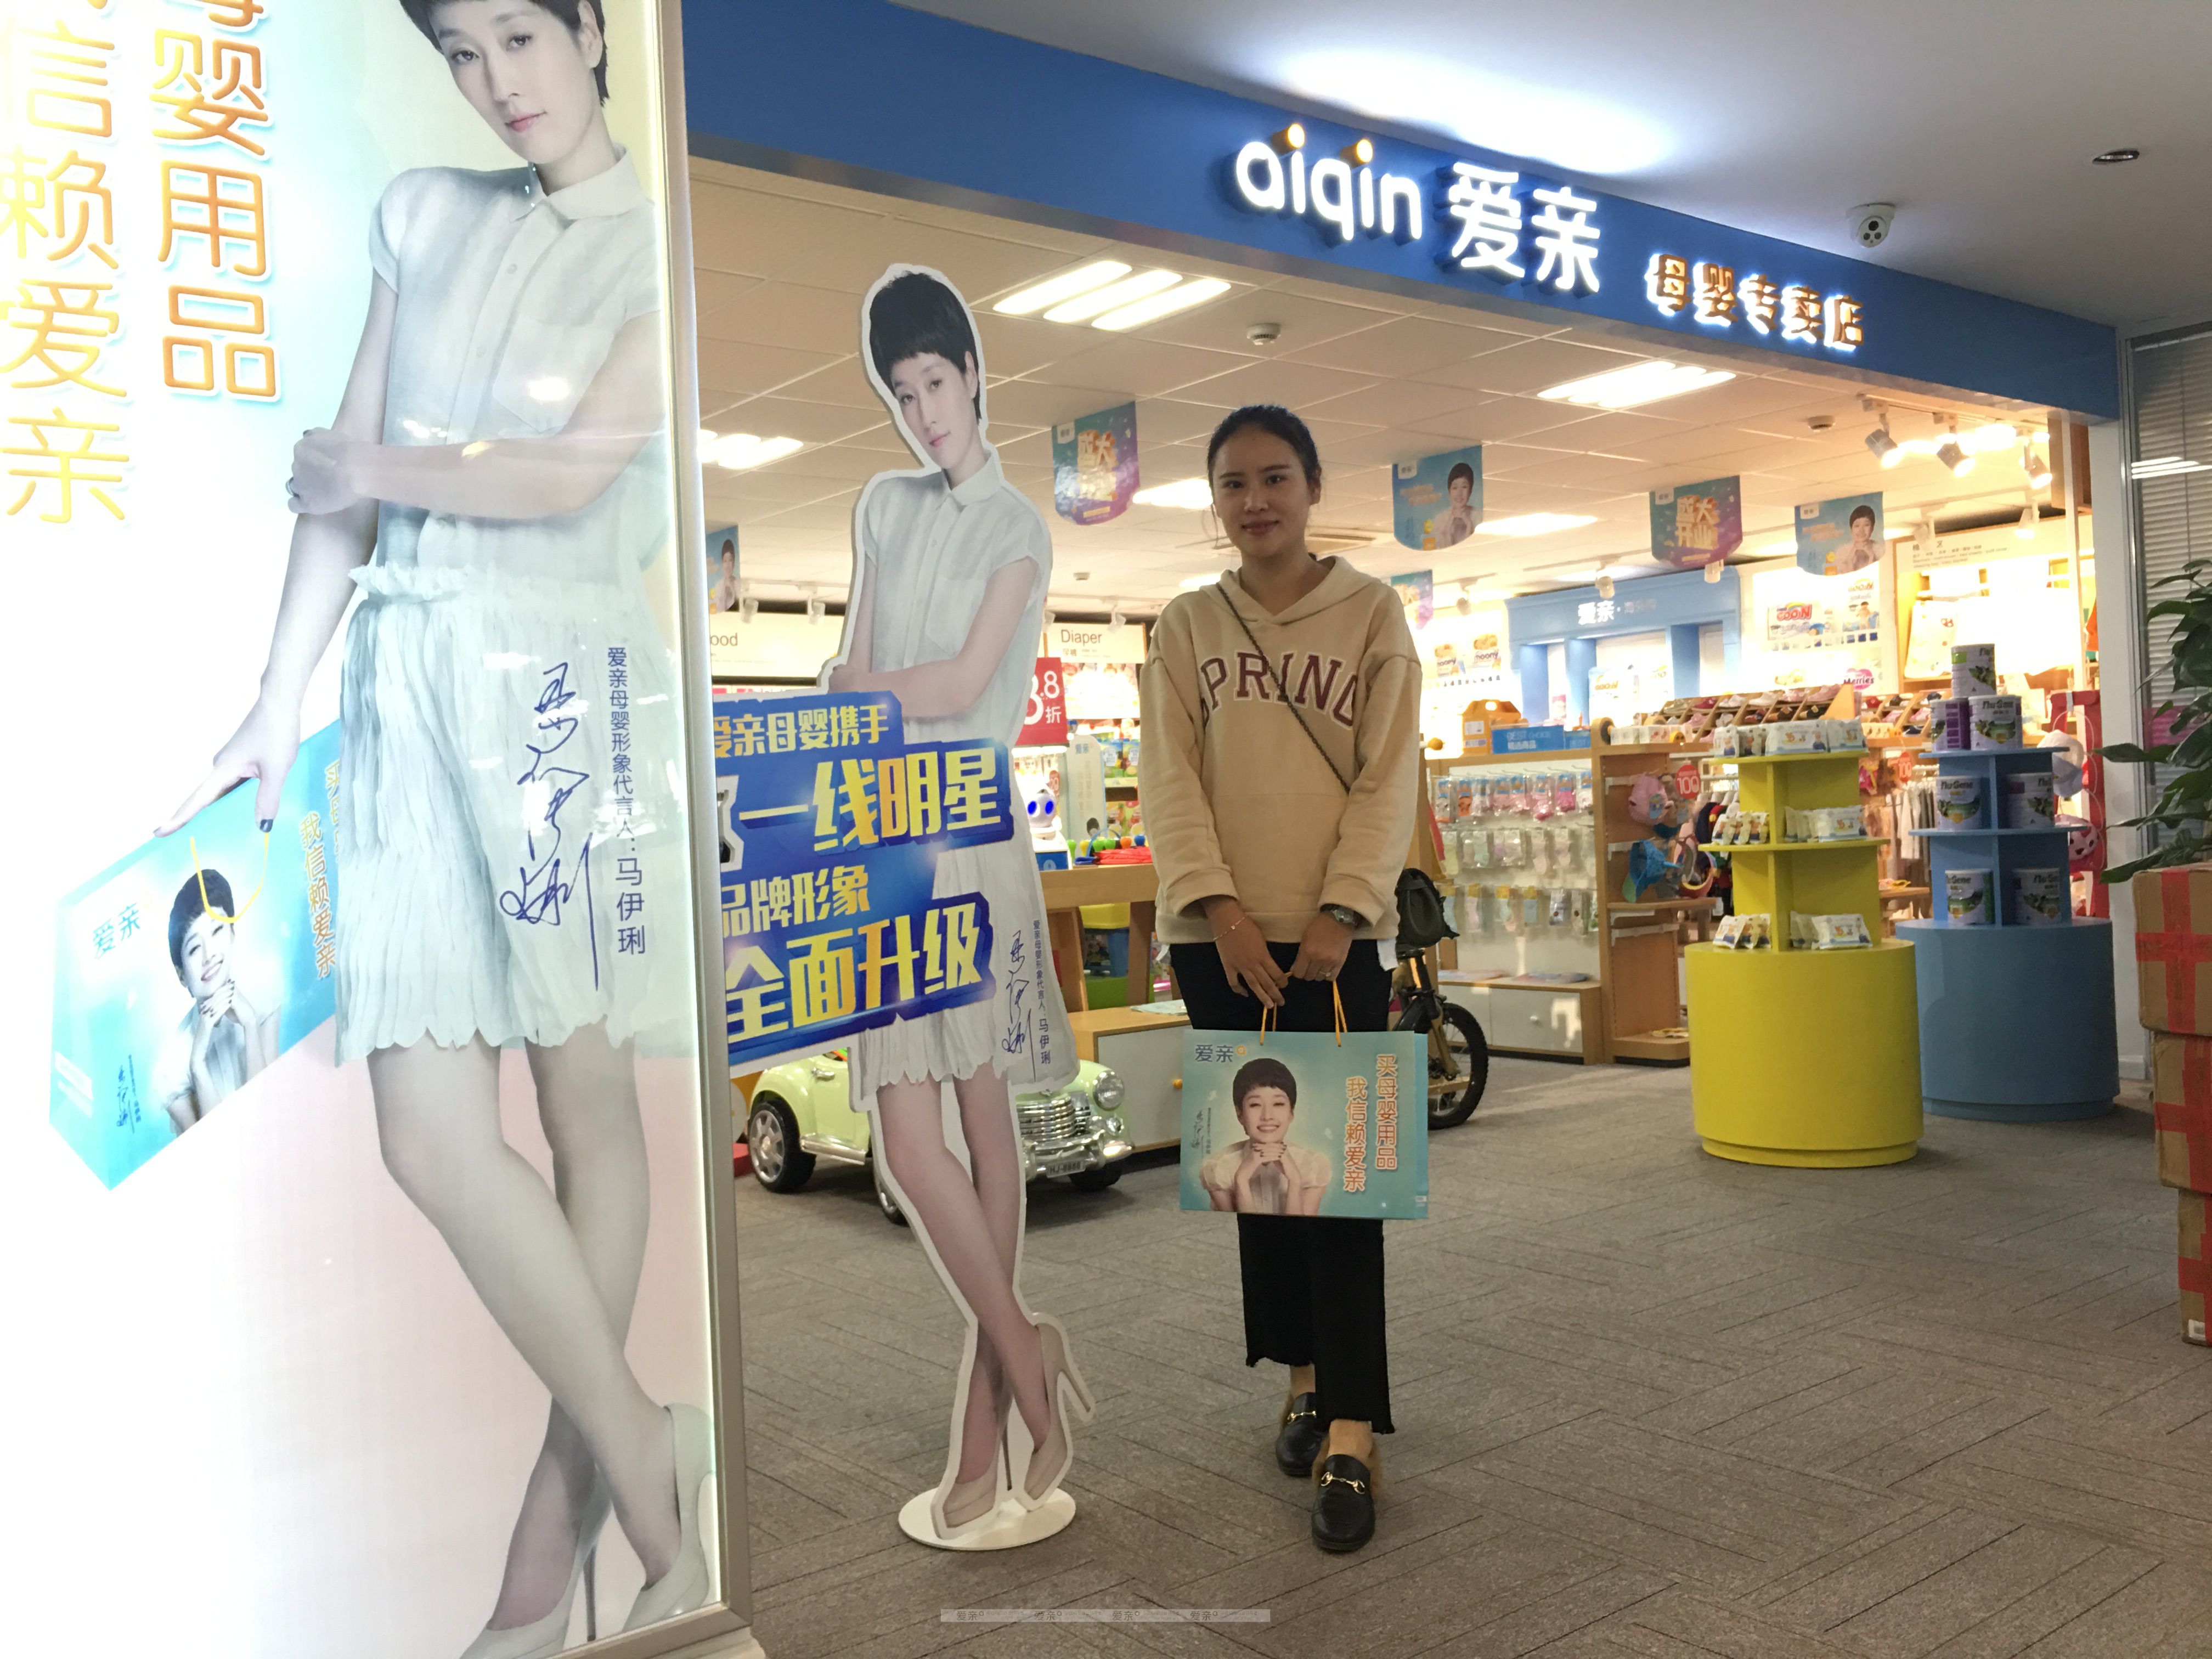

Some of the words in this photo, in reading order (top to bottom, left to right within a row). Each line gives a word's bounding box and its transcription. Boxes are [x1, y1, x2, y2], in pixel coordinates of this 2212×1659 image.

[0, 0, 128, 524] 信赖爱亲
[1236, 122, 1422, 240] aiqin
[1448, 161, 1600, 293] 爱亲
[1646, 253, 1865, 351] 母婴专卖店
[711, 632, 738, 646] ood
[1061, 629, 1102, 646] Diaper
[1199, 651, 1358, 729] PRIN
[714, 704, 888, 758] 爱亲母婴携手
[92, 902, 142, 959] 爱亲
[301, 812, 336, 978] 我信赖爱亲
[721, 865, 870, 936] 品牌形象
[726, 902, 983, 1042] 全面升级
[1195, 1044, 1234, 1063] 爱亲
[1344, 1076, 1368, 1193] 我信赖爱亲
[1376, 1054, 1398, 1170] 买母婴用品
